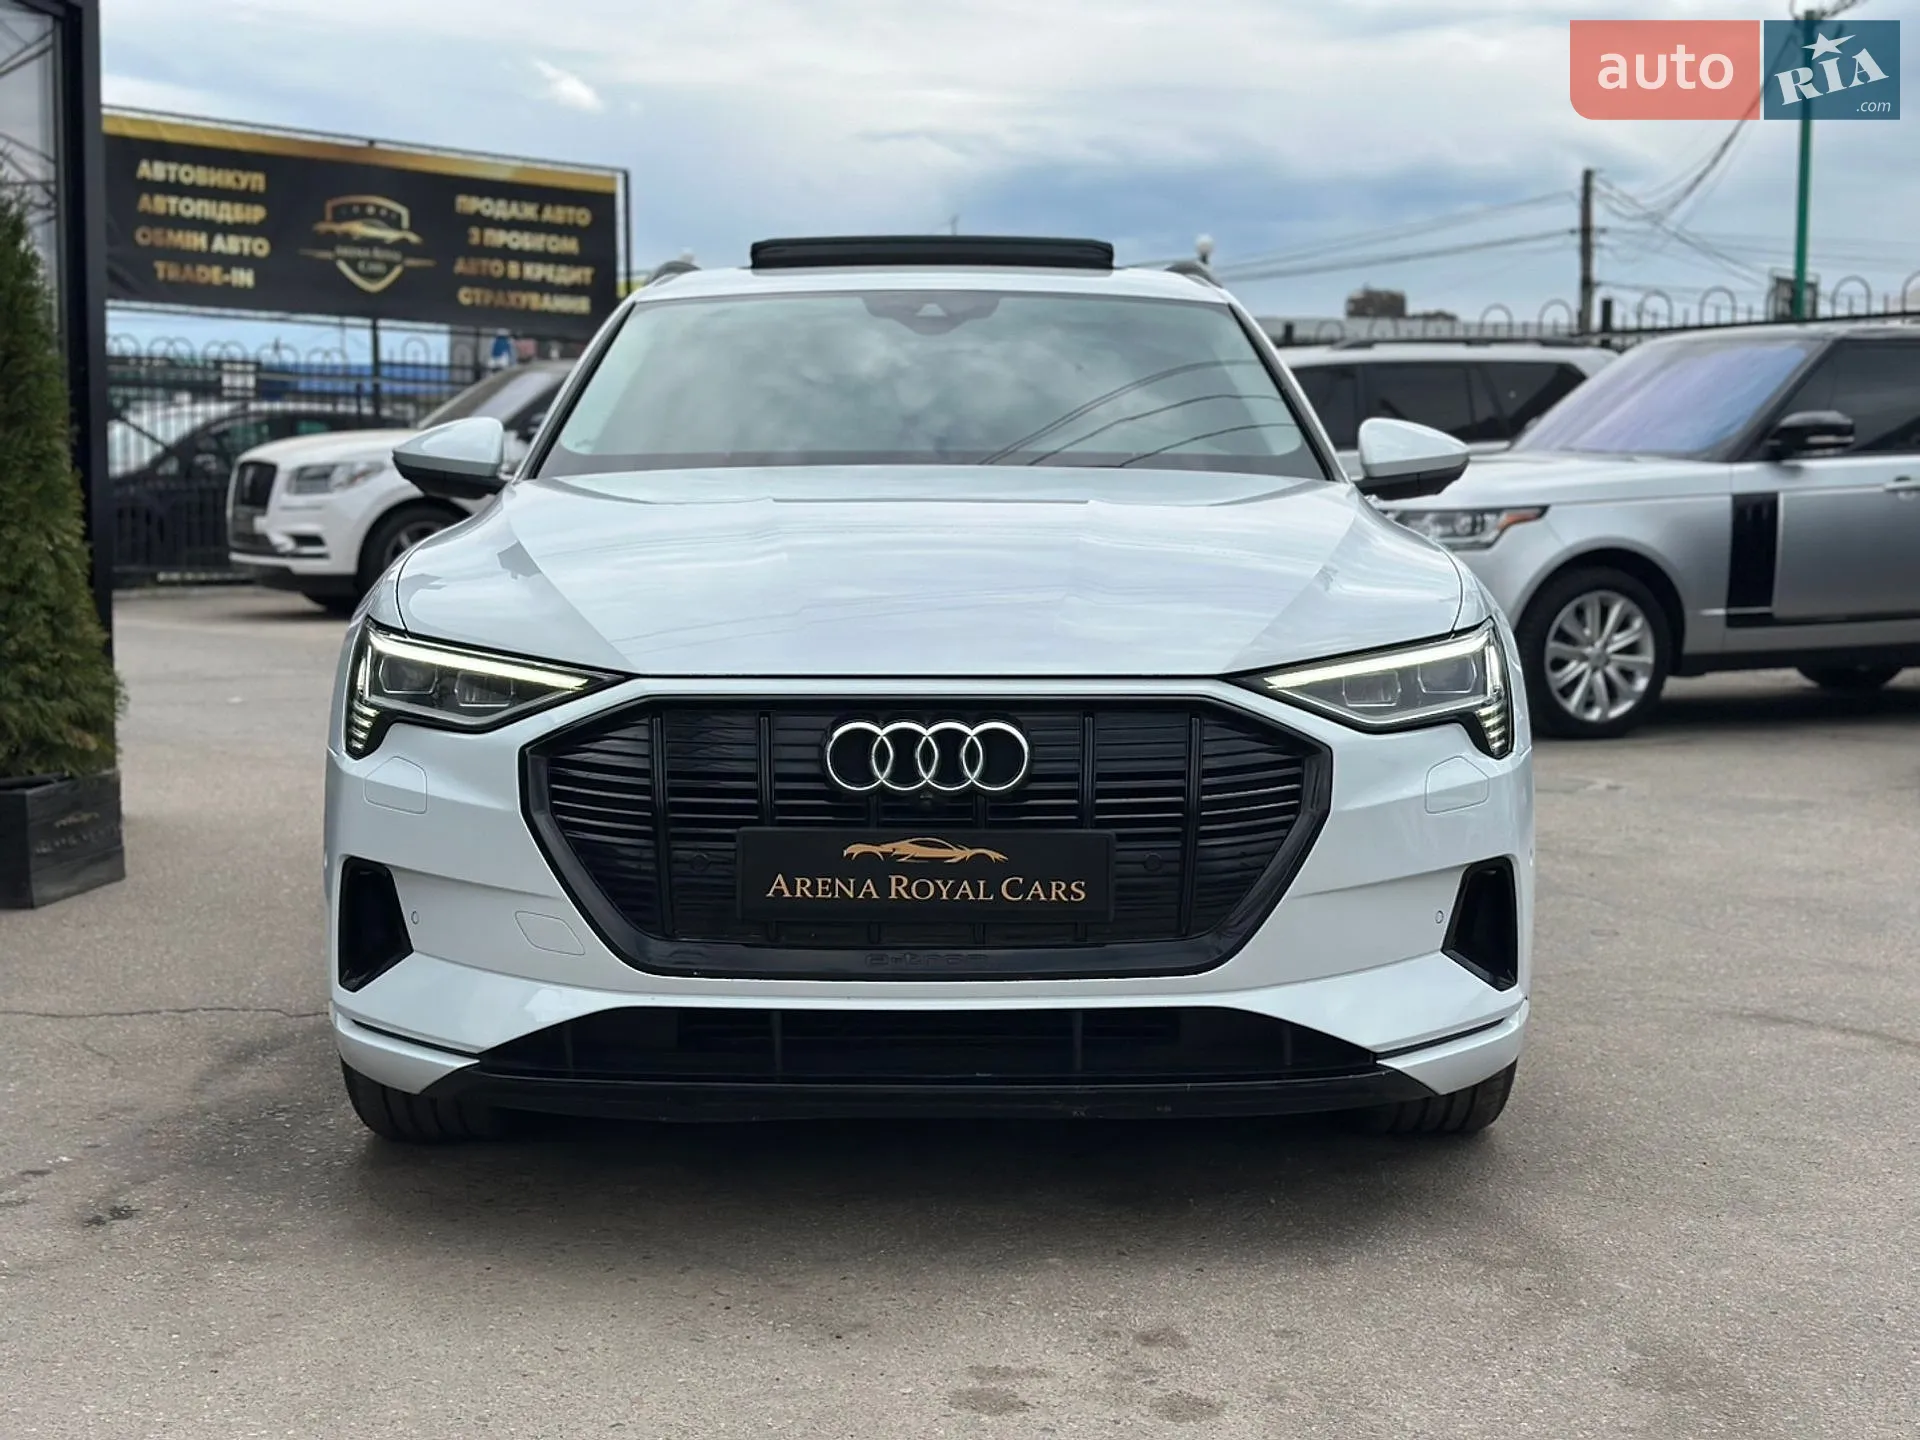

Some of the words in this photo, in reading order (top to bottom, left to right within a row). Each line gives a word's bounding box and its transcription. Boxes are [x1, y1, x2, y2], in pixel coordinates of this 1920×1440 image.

[136, 158, 265, 193] АВТОВИКУП
[455, 194, 540, 222] ПРОДАЖ
[541, 203, 592, 227] АВТО
[210, 232, 271, 258] АВТО
[153, 260, 255, 289] TRADE-IN
[454, 257, 505, 278] АВТО
[522, 262, 595, 286] КРЕДИТ
[765, 873, 880, 899] ARENA
[887, 874, 994, 901] ROYAL
[1000, 876, 1087, 902] CARS
